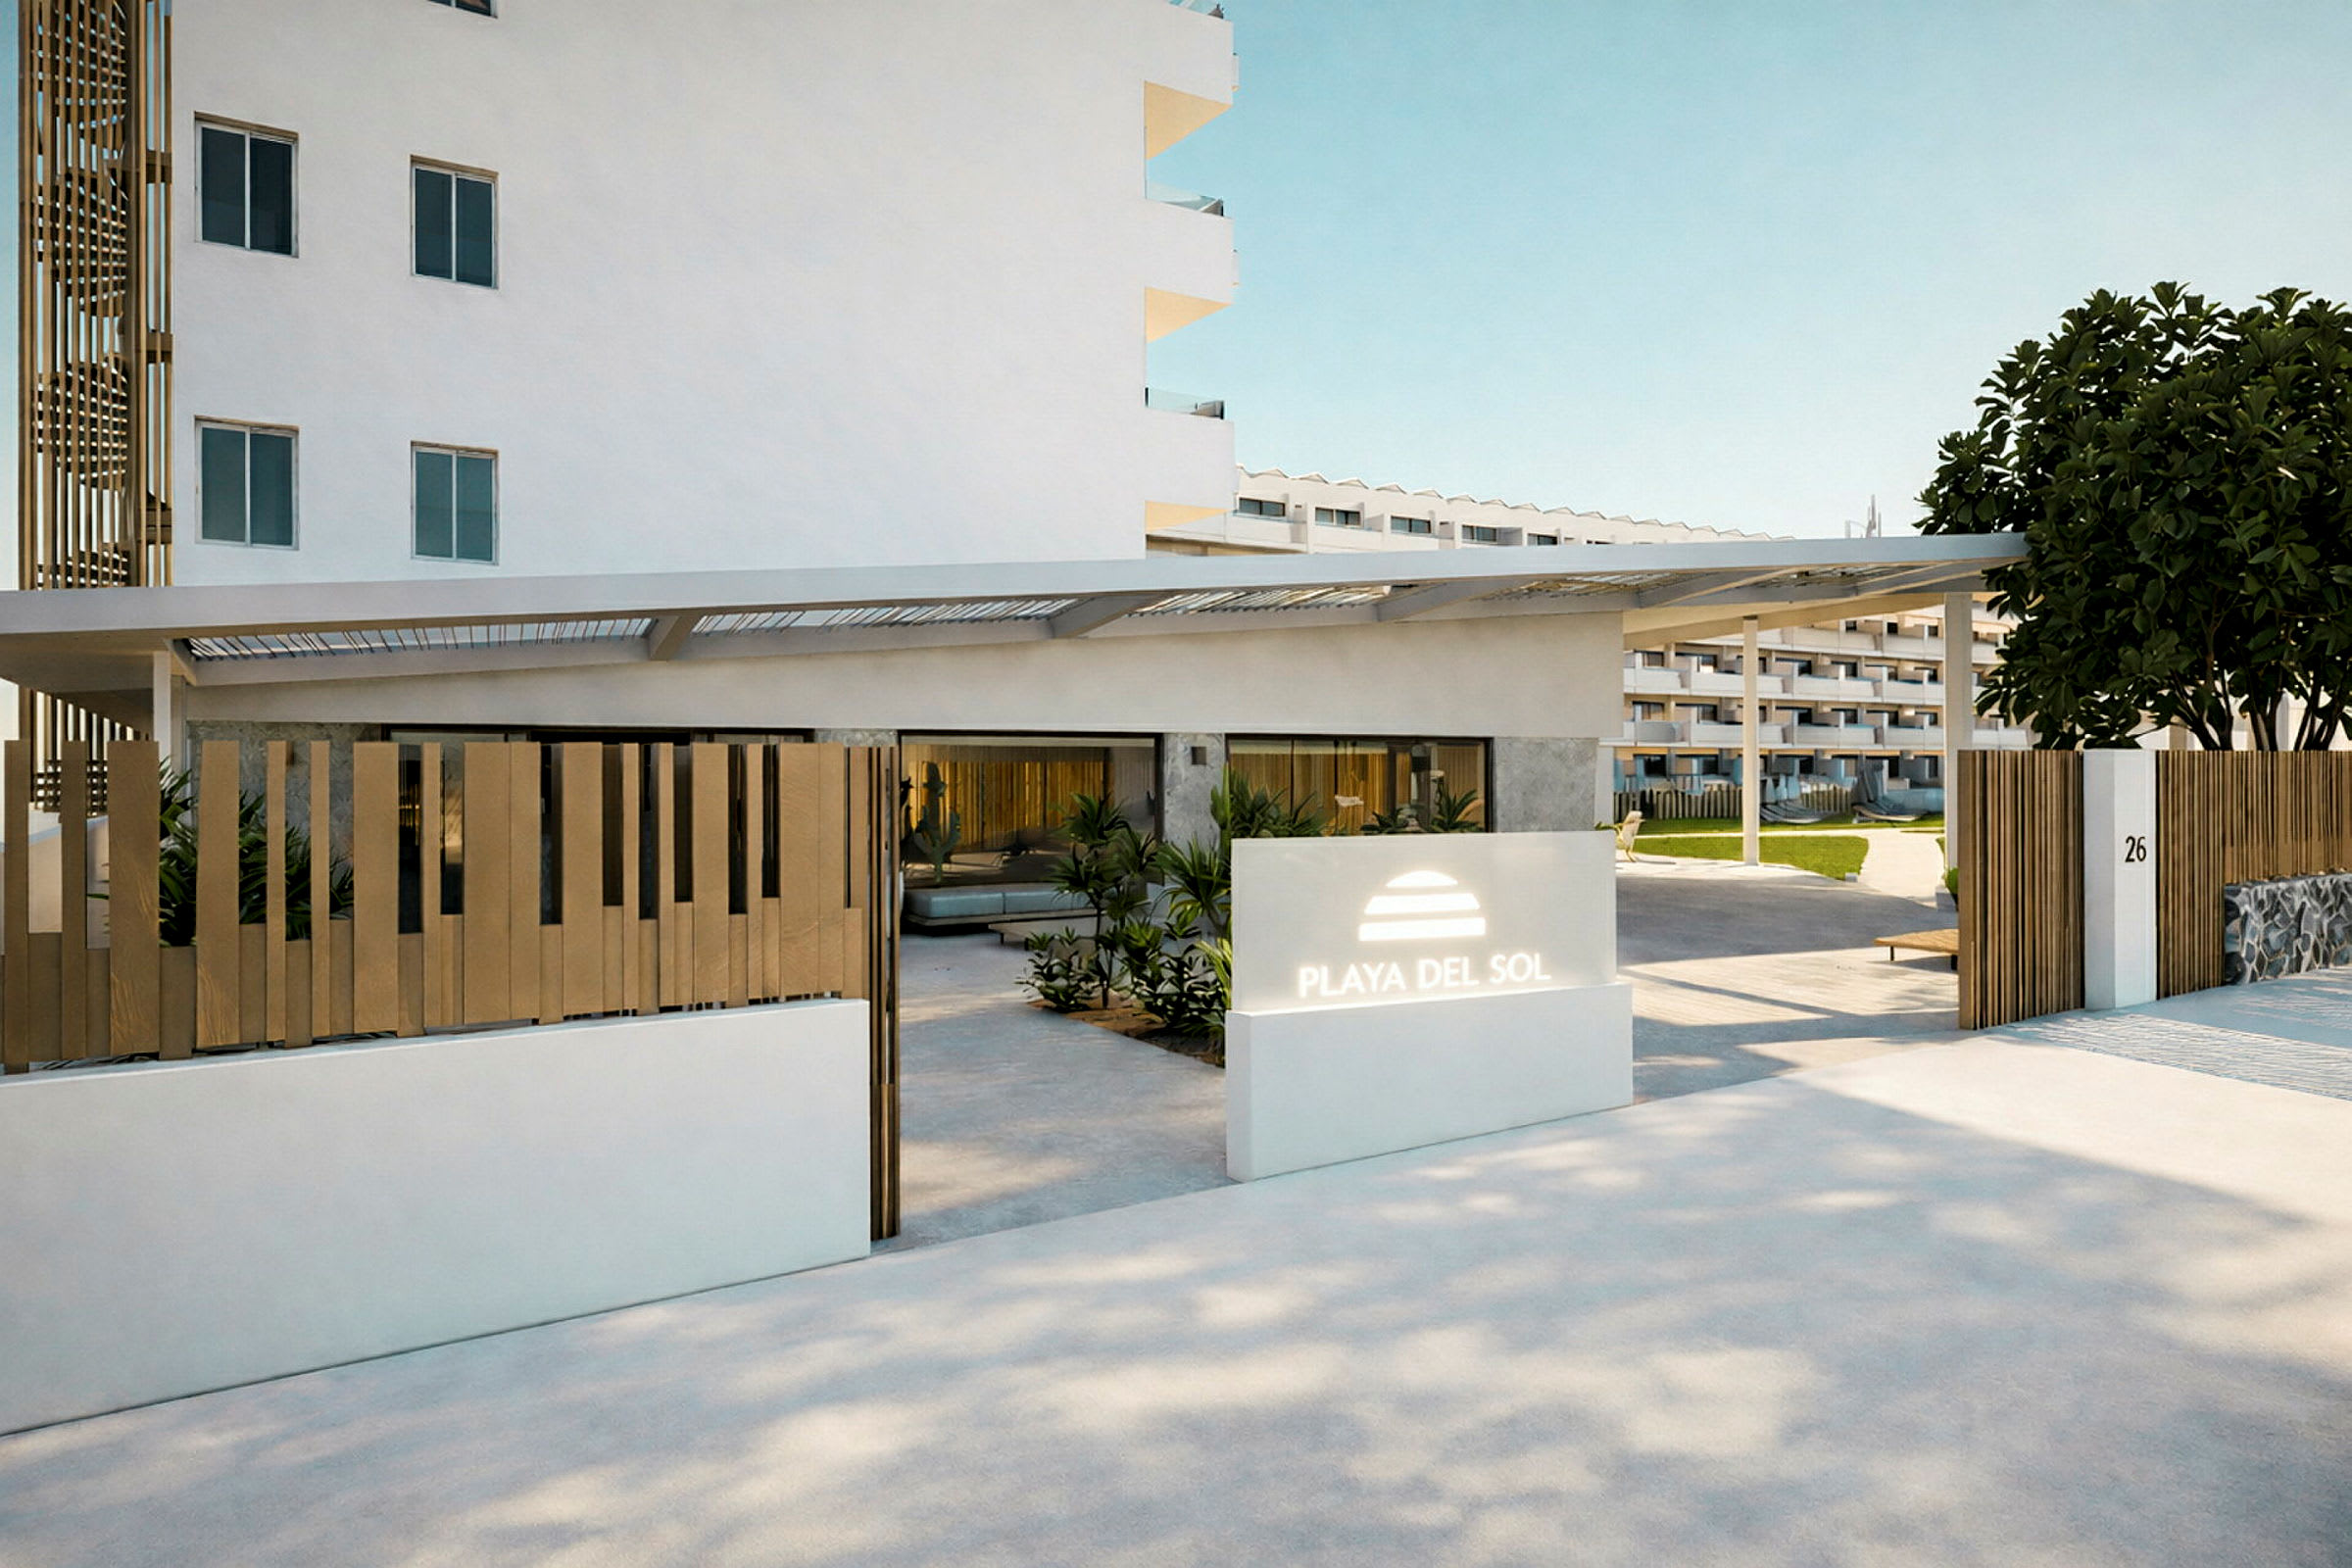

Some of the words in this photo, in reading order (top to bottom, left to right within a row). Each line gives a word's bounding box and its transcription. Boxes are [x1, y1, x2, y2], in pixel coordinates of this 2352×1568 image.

[2125, 835, 2147, 862] 26
[1298, 962, 1406, 998] PLAYA
[1418, 956, 1479, 989] DEL
[1490, 953, 1551, 984] SOL
